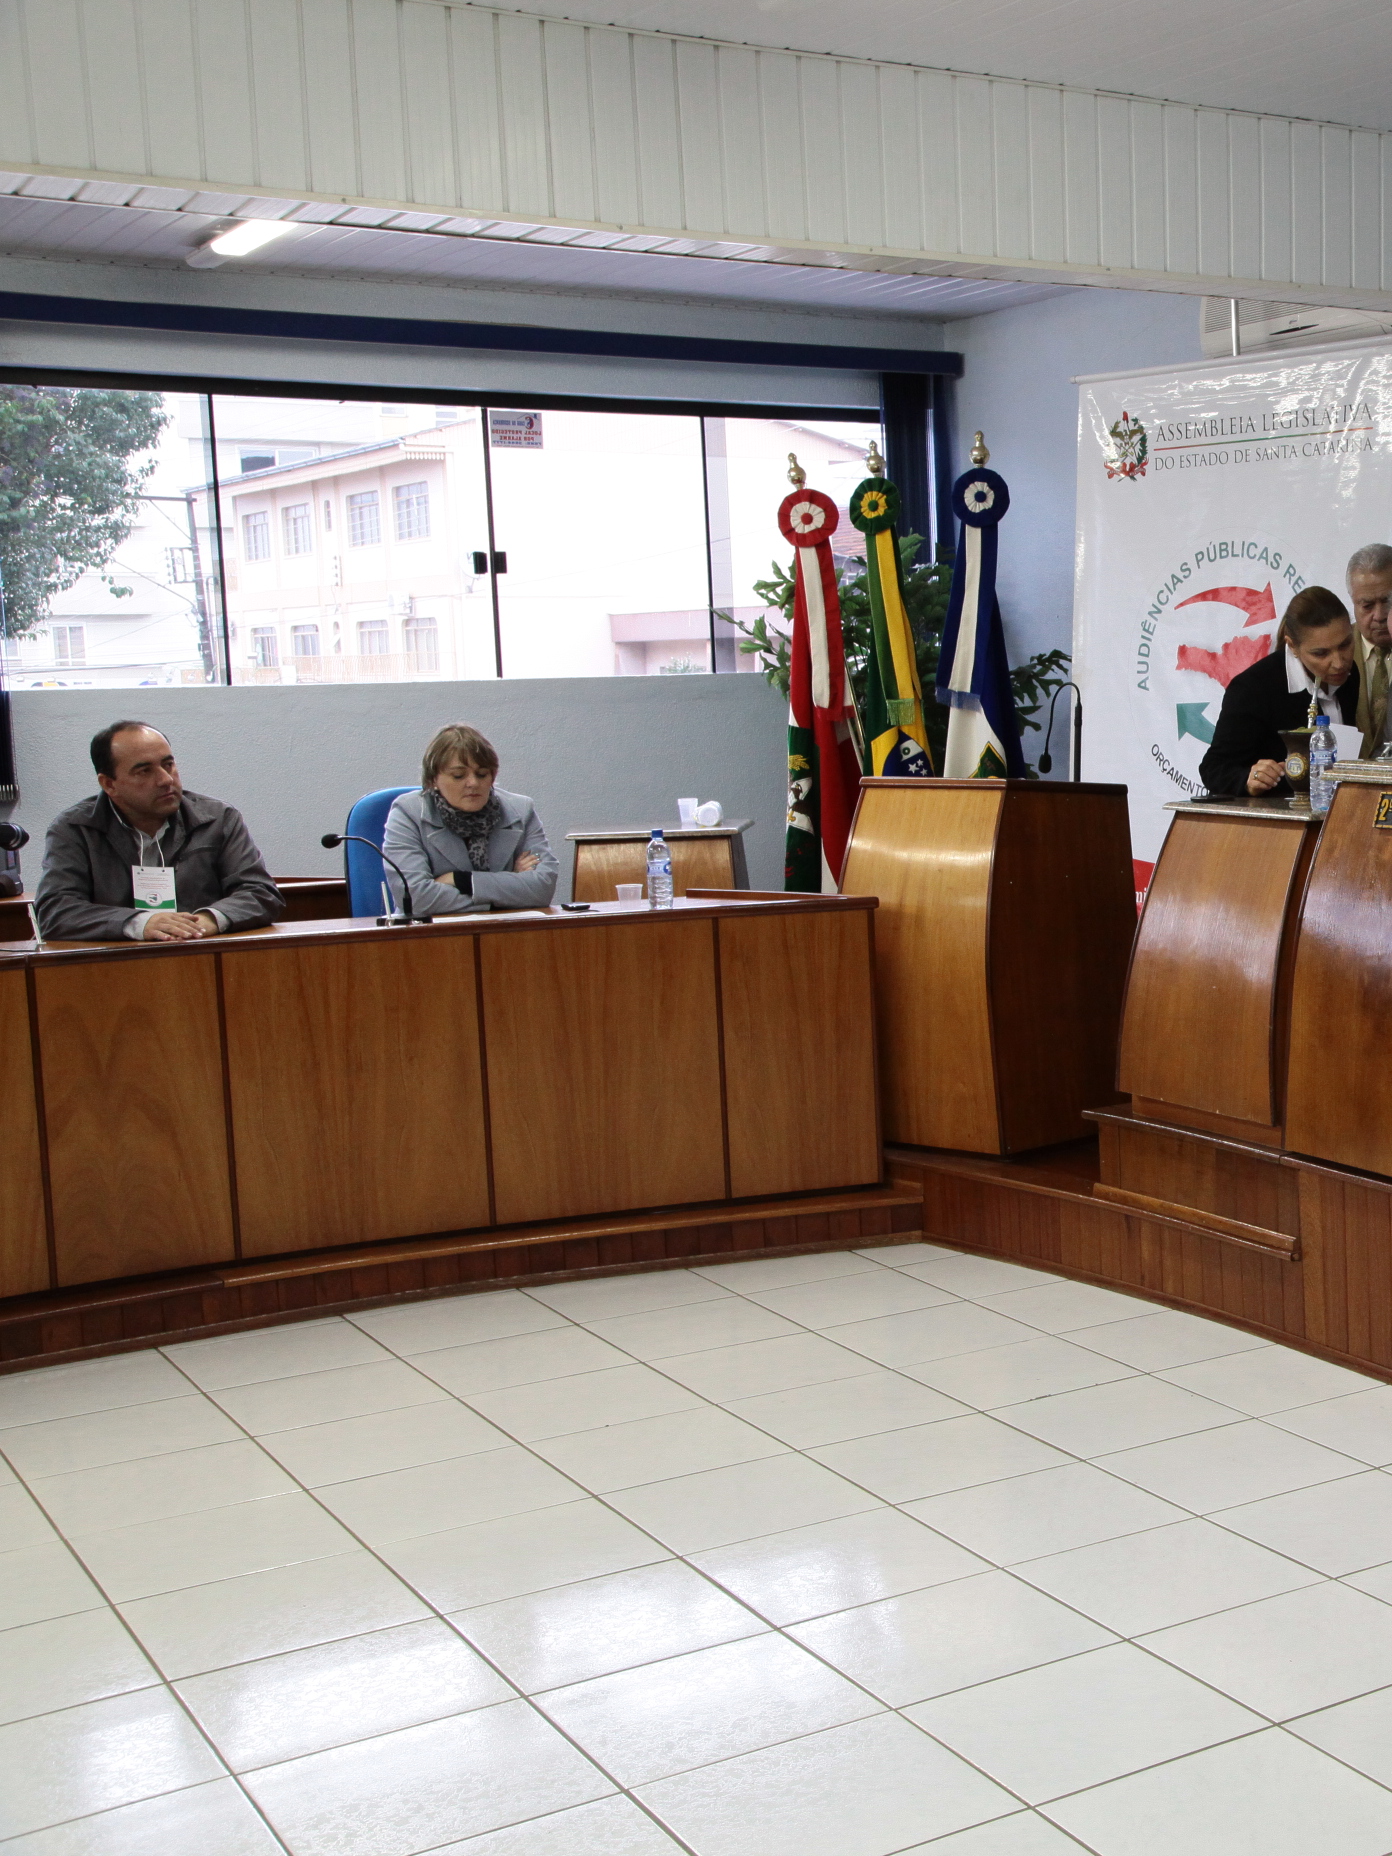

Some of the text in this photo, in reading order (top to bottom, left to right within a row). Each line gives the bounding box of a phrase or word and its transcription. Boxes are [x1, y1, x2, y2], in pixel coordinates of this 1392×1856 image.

[1155, 402, 1373, 443] ASSEMBLEIA LEGISLATIVA
[1154, 437, 1373, 471] DO ESTADO DE SANTA CATARINA
[1136, 541, 1306, 692] AUDIÊNCIAS PÚBLICAS RE
[1151, 743, 1208, 797] ORÇAMENTO
